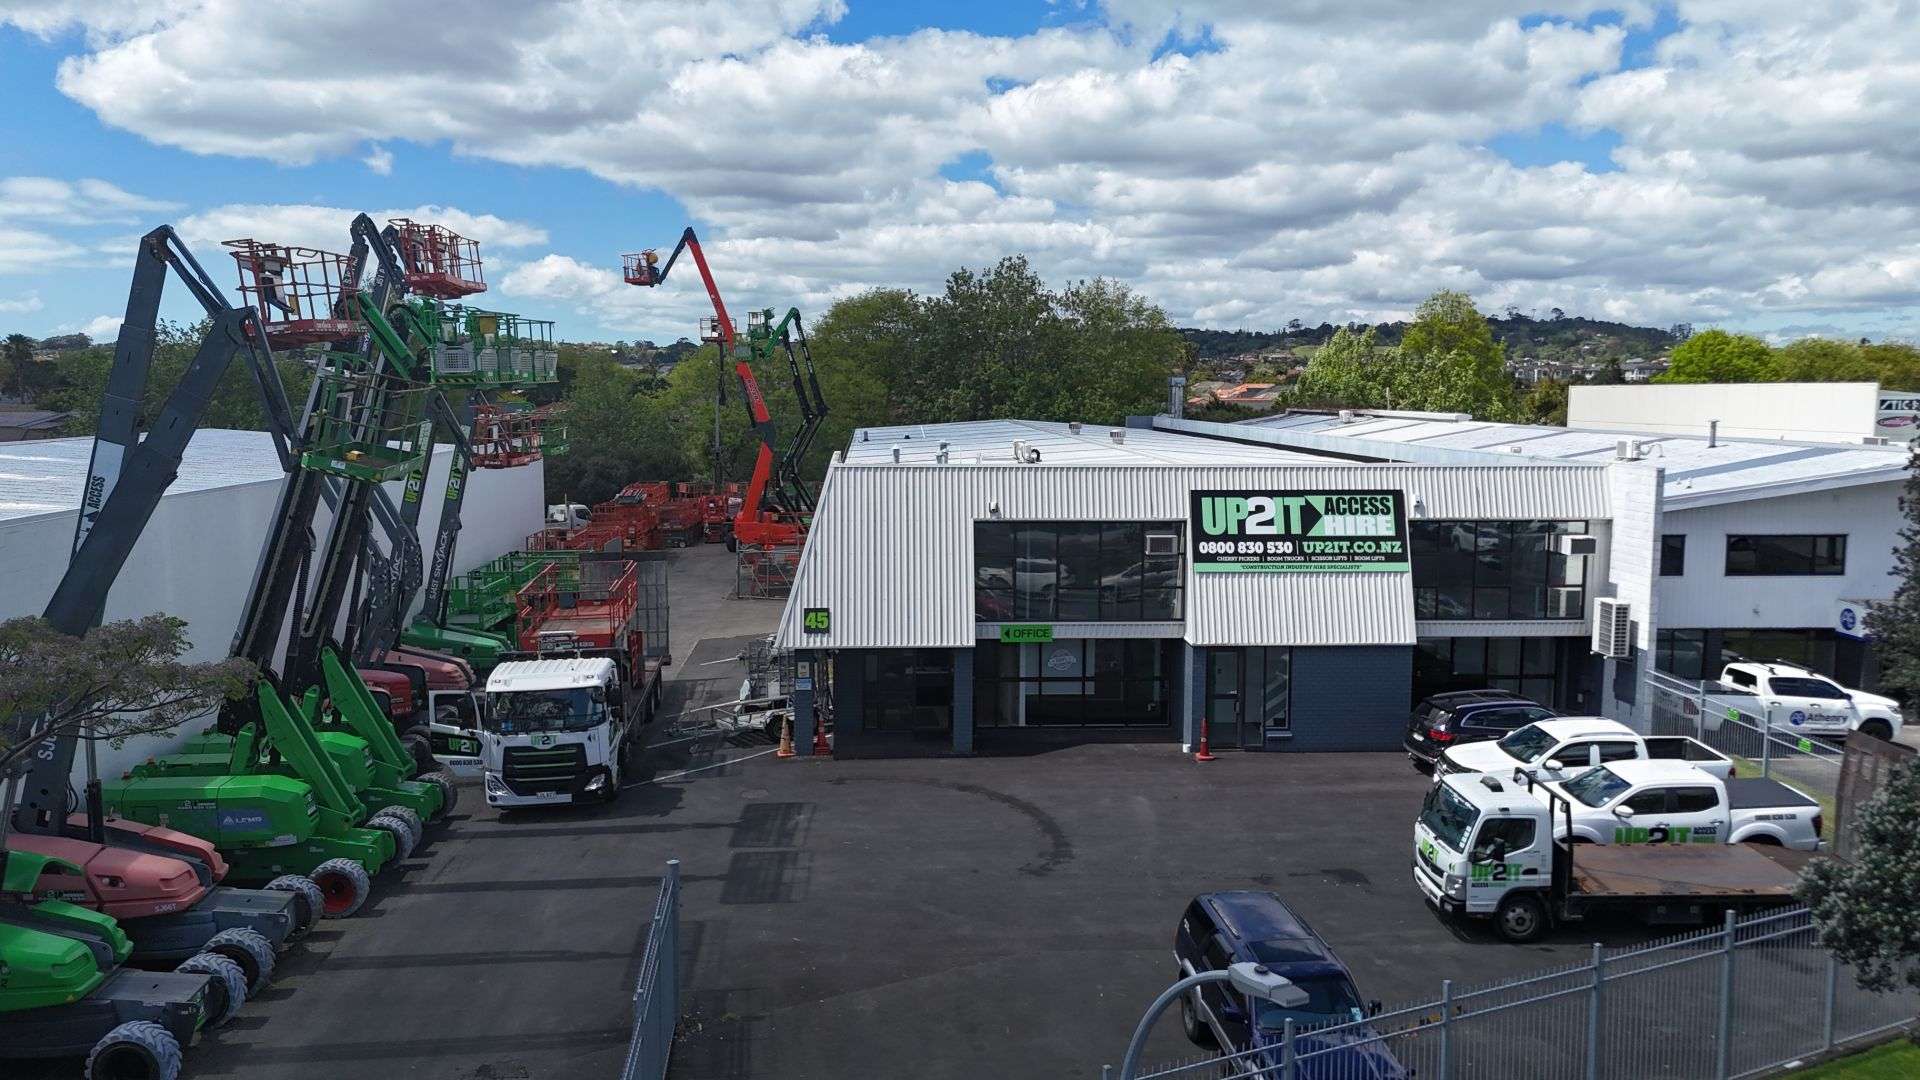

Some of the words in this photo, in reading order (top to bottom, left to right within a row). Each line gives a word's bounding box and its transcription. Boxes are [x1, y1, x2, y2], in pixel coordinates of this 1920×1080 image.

[87, 475, 106, 509] ACCESS
[1324, 496, 1391, 516] ACCESS
[1201, 496, 1305, 536] UP2IT
[1323, 516, 1395, 536] HIRE
[433, 530, 449, 577] SKYJACK
[1199, 541, 1235, 554] 0800
[1237, 541, 1264, 554] 830
[1266, 541, 1293, 554] 530
[1302, 541, 1402, 554] UP2IT.CO.NZ
[804, 611, 829, 630] 45
[1013, 628, 1050, 638] OFFICE
[1807, 712, 1849, 722] Athenry
[448, 737, 478, 754] UP2IT
[530, 735, 558, 746] UP2IT
